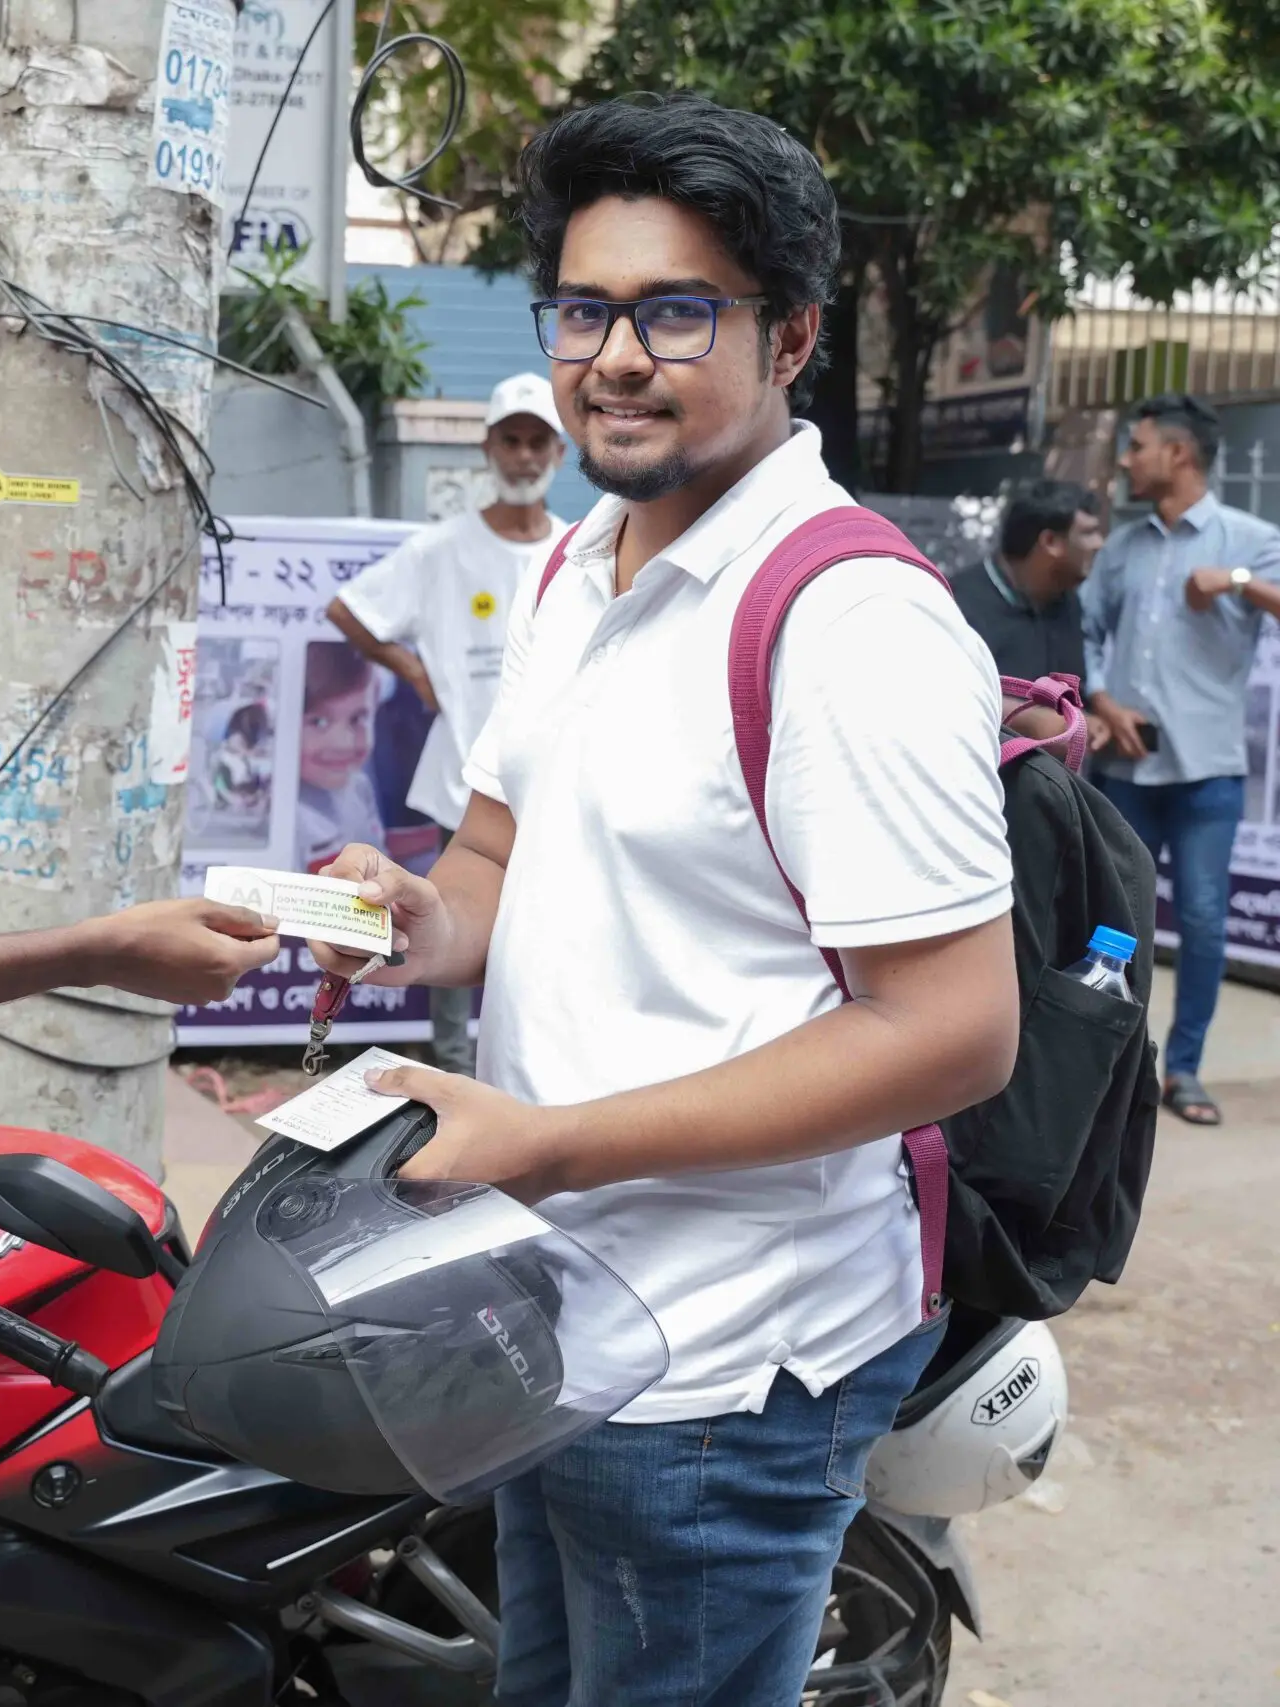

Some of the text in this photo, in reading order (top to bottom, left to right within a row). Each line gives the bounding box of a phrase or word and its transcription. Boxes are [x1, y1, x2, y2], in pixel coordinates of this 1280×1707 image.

[273, 557, 317, 592] ২২
[307, 899, 330, 910] TEXT
[331, 903, 352, 914] AND
[353, 907, 381, 921] DRIVE
[981, 1363, 1037, 1421] INDEX
